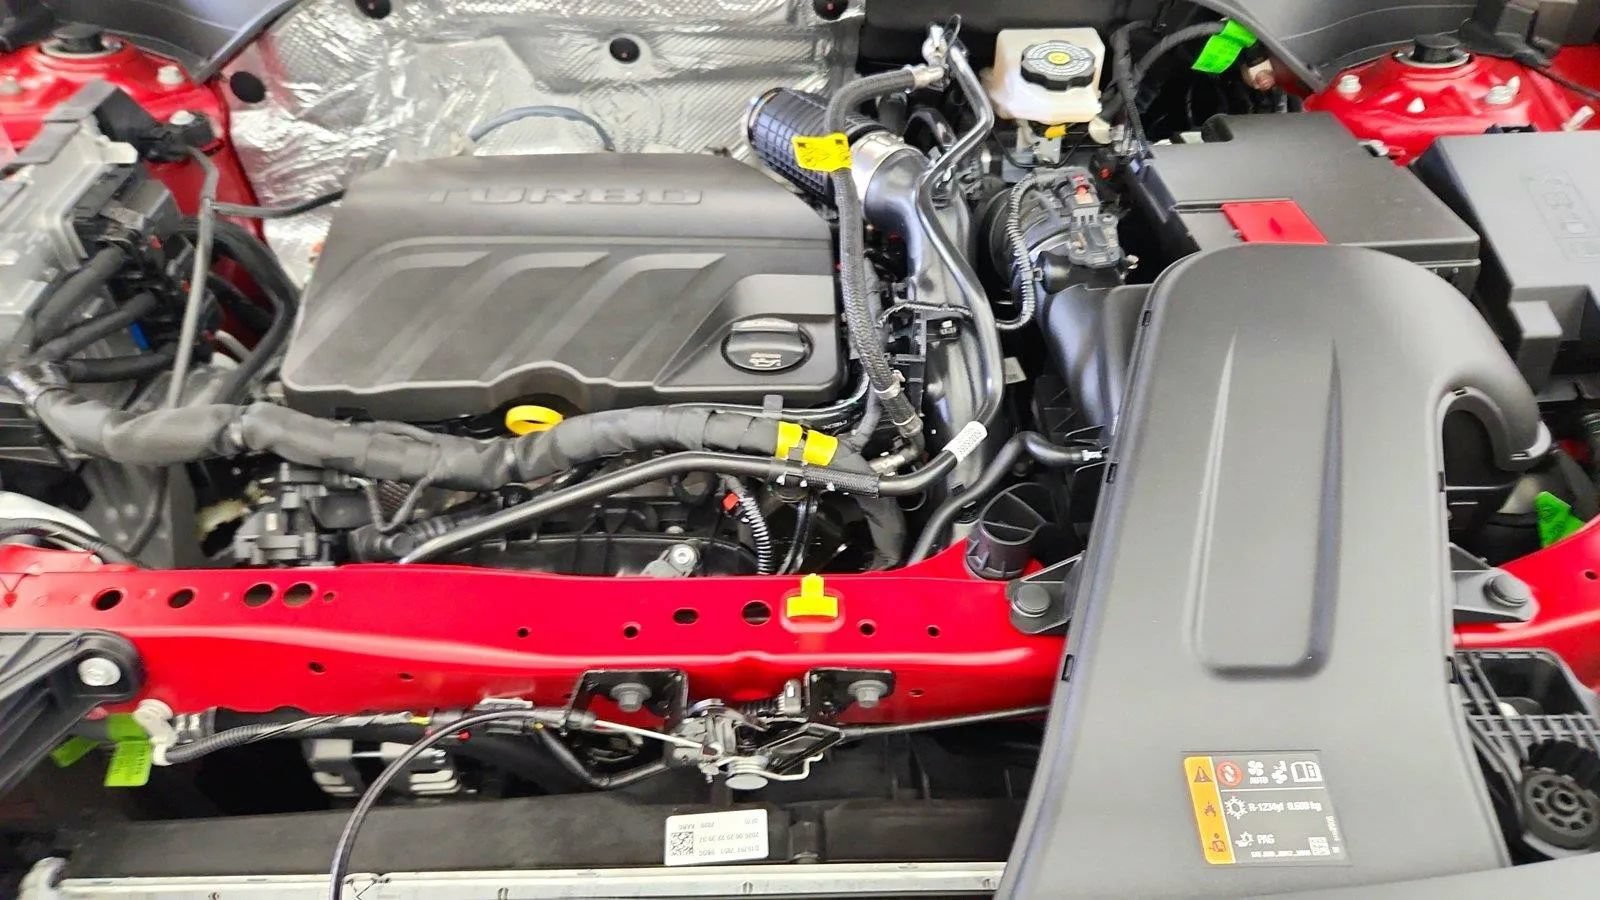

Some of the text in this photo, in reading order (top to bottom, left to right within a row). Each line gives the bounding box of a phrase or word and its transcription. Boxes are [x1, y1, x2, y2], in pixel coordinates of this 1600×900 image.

[428, 185, 703, 206] TURBO
[1310, 801, 1322, 812] kg
[1257, 834, 1275, 845] PAG
